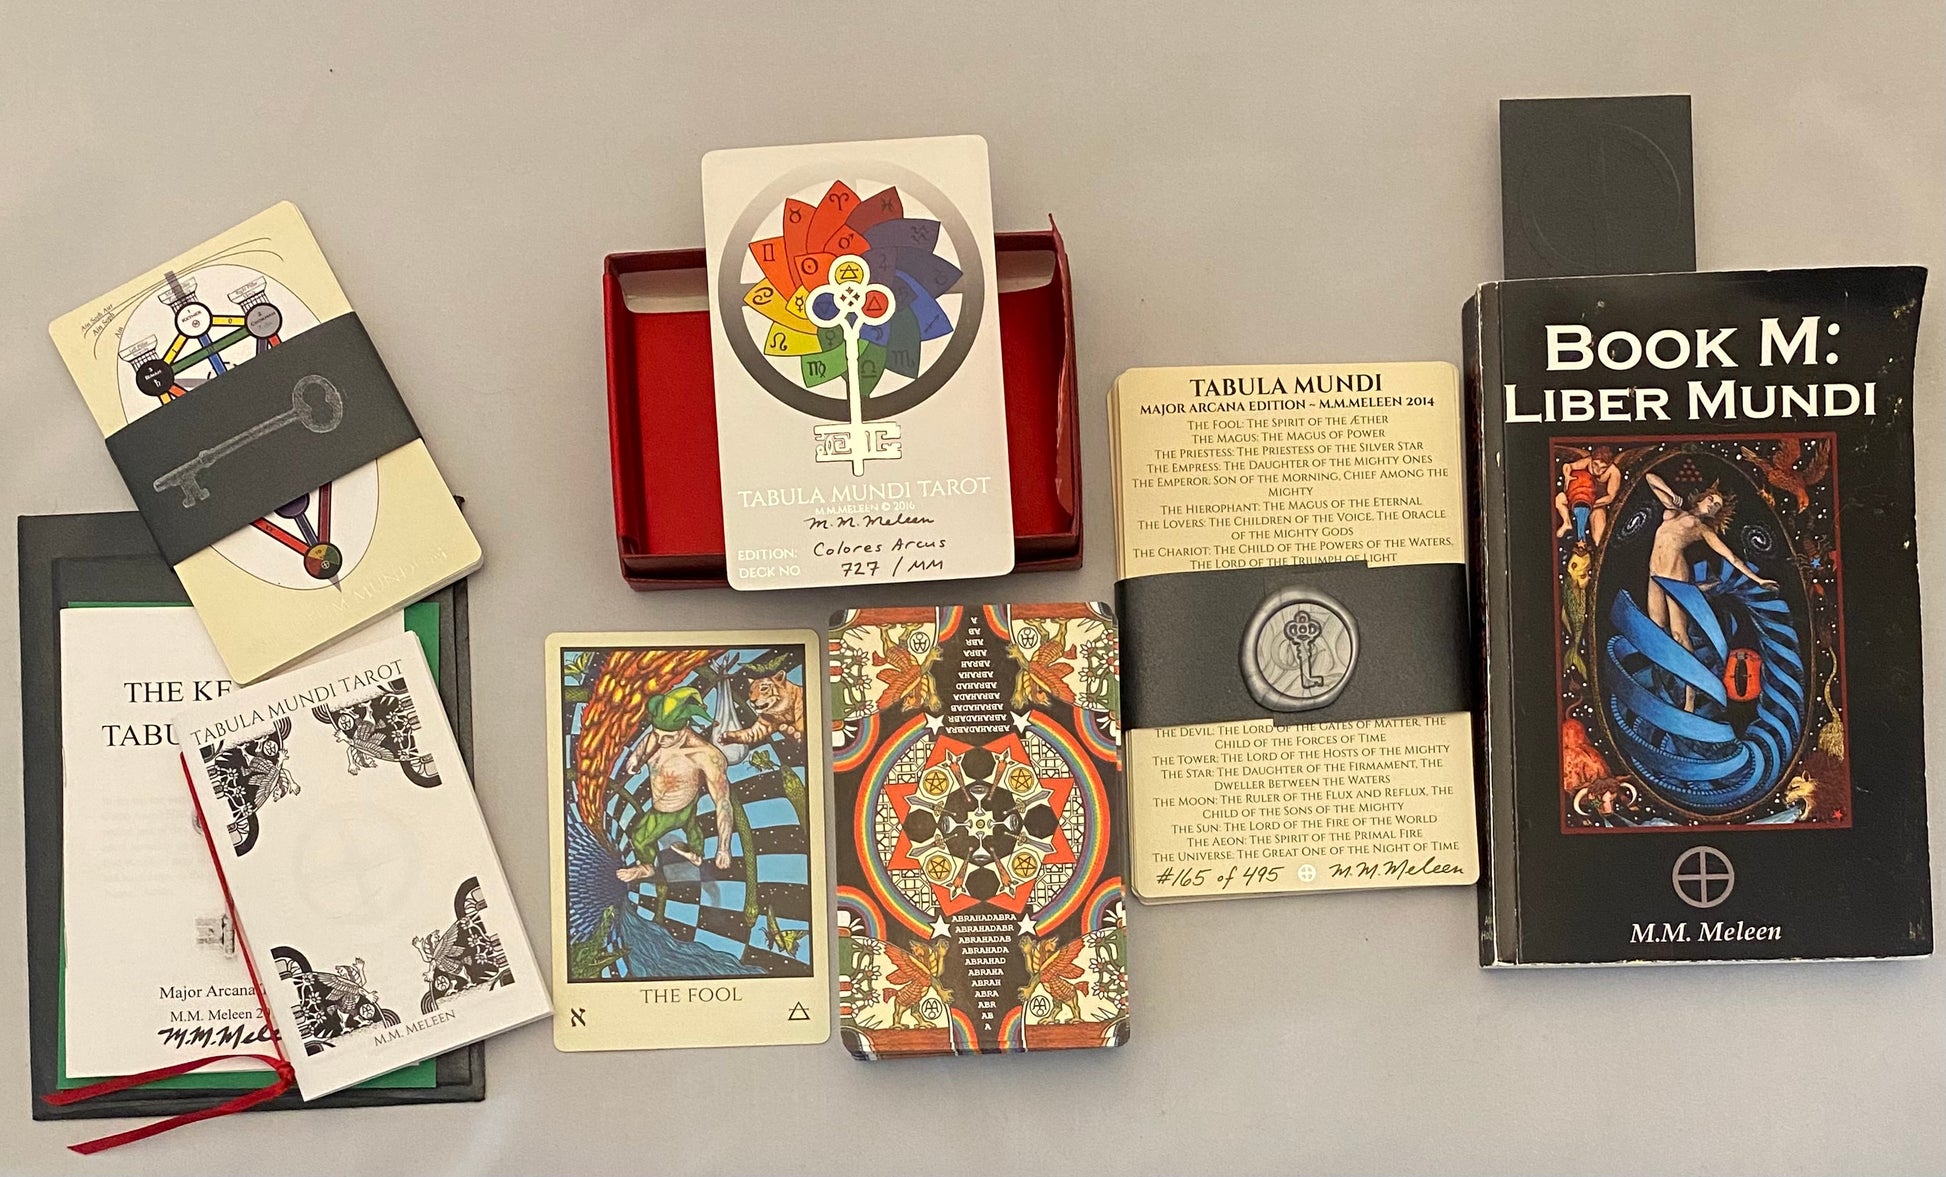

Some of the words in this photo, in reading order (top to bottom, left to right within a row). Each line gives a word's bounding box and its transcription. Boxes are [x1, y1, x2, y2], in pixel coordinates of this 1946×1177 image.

[1545, 325, 1738, 371] BOOK
[1759, 315, 1840, 367] M:
[1190, 378, 1288, 396] TABULA
[1294, 374, 1382, 394] MUNDI
[1140, 404, 1186, 415] MAJOR
[1188, 402, 1246, 412] ARCANA
[1248, 400, 1306, 412] EDITION
[1320, 397, 1402, 408] M.M.MELEEN
[1406, 396, 1434, 406] 2014
[1504, 384, 1671, 424] LIBER
[1688, 380, 1876, 421] MUNDI
[1186, 420, 1210, 430] THE
[1246, 418, 1268, 428] THE
[1272, 418, 1306, 428] SPIRIT
[1308, 418, 1322, 426] OF
[1324, 416, 1346, 426] THE
[1350, 414, 1388, 424] ÆTHER
[1192, 434, 1214, 444] THE
[1262, 432, 1284, 442] THE
[1286, 430, 1326, 440] MAGUS
[1328, 430, 1344, 440] OF
[1348, 428, 1386, 438] POWER
[1154, 450, 1176, 460] THE
[1236, 446, 1258, 456] THE
[1262, 446, 1314, 456] PRIESTESS
[1318, 444, 1332, 454] OF
[1334, 444, 1356, 452] THE
[1360, 442, 1396, 452] SILVER
[1398, 440, 1424, 450] STAR
[1146, 464, 1168, 474] THE
[1224, 460, 1246, 470] THE
[1248, 460, 1310, 470] DAUGHTER
[1312, 458, 1326, 468] OF
[1328, 458, 1352, 466] THE
[1354, 456, 1400, 466] MIGHTY
[1402, 454, 1432, 464] ONES
[738, 488, 824, 508] TABULA
[832, 483, 911, 502] MUNDI
[918, 477, 991, 497] TAROT
[893, 501, 915, 511] 2016
[1160, 504, 1182, 516] THE
[1262, 502, 1286, 512] THE
[1288, 500, 1328, 510] MAGUS
[1330, 500, 1346, 508] OF
[1348, 498, 1370, 508] THE
[1374, 496, 1422, 506] ETERNAL
[814, 541, 882, 557] Colores
[892, 537, 946, 550] Arcus
[739, 566, 775, 578] DECK
[779, 565, 800, 577] NO
[842, 561, 880, 577] 727
[124, 681, 184, 703] THE
[193, 680, 232, 701] KE
[190, 710, 264, 746] TABULA
[268, 684, 336, 719] MUNDI
[338, 659, 402, 693] TAROT
[102, 724, 179, 747] TABU
[1152, 756, 1174, 766] THE
[1220, 752, 1244, 762] THE
[1246, 752, 1278, 762] LORD
[1280, 752, 1296, 760] OF
[1298, 750, 1320, 760] THE
[1324, 748, 1358, 758] HOSTS
[1362, 748, 1376, 756] OF
[1378, 746, 1402, 756] THE
[1404, 744, 1450, 754] MIGHTY
[1160, 770, 1184, 780] THE
[1216, 766, 1240, 776] THE
[1241, 764, 1304, 776] DAUGHTER
[1306, 764, 1320, 774] OF
[1324, 762, 1346, 772] THE
[1420, 758, 1442, 768] THE
[1214, 780, 1266, 790] DWELLER
[1268, 778, 1320, 788] BETWEEN
[1322, 776, 1345, 786] THE
[1348, 774, 1390, 784] WATERS
[1170, 824, 1194, 834] THE
[1224, 822, 1246, 832] THE
[1250, 822, 1280, 830] LORD
[1284, 820, 1298, 830] OF
[1300, 820, 1322, 828] THE
[1326, 818, 1350, 828] FIRE
[1352, 818, 1368, 826] OF
[1370, 816, 1392, 826] THE
[1394, 814, 1438, 824] WORLD
[1157, 866, 1213, 887] #165
[1217, 865, 1239, 889] of
[1243, 866, 1285, 887] 495
[1382, 856, 1464, 880] Meleen
[952, 913, 1017, 922] ABRAHADABRA
[955, 924, 1014, 933] ABRAHADABR
[1630, 922, 1691, 943] M.M.
[1698, 921, 1782, 942] Meleen
[958, 935, 1012, 944] ABRAHADAB
[962, 946, 1009, 955] ABRAHADA
[965, 957, 1006, 966] ABRAHAD
[968, 968, 1004, 976] ABRAHA
[971, 979, 1000, 987] ABRAH
[160, 986, 202, 1002] Major
[206, 984, 255, 997] Arcana
[640, 989, 680, 1004] THE
[688, 987, 742, 1003] FOOL
[975, 990, 999, 998] ABRA
[978, 1001, 996, 1009] ABR
[170, 1011, 204, 1023] M.M.
[208, 1008, 253, 1021] Meleen
[981, 1012, 994, 1020] AB
[374, 1033, 404, 1047] M.M.
[406, 1009, 456, 1036] MELEEN
